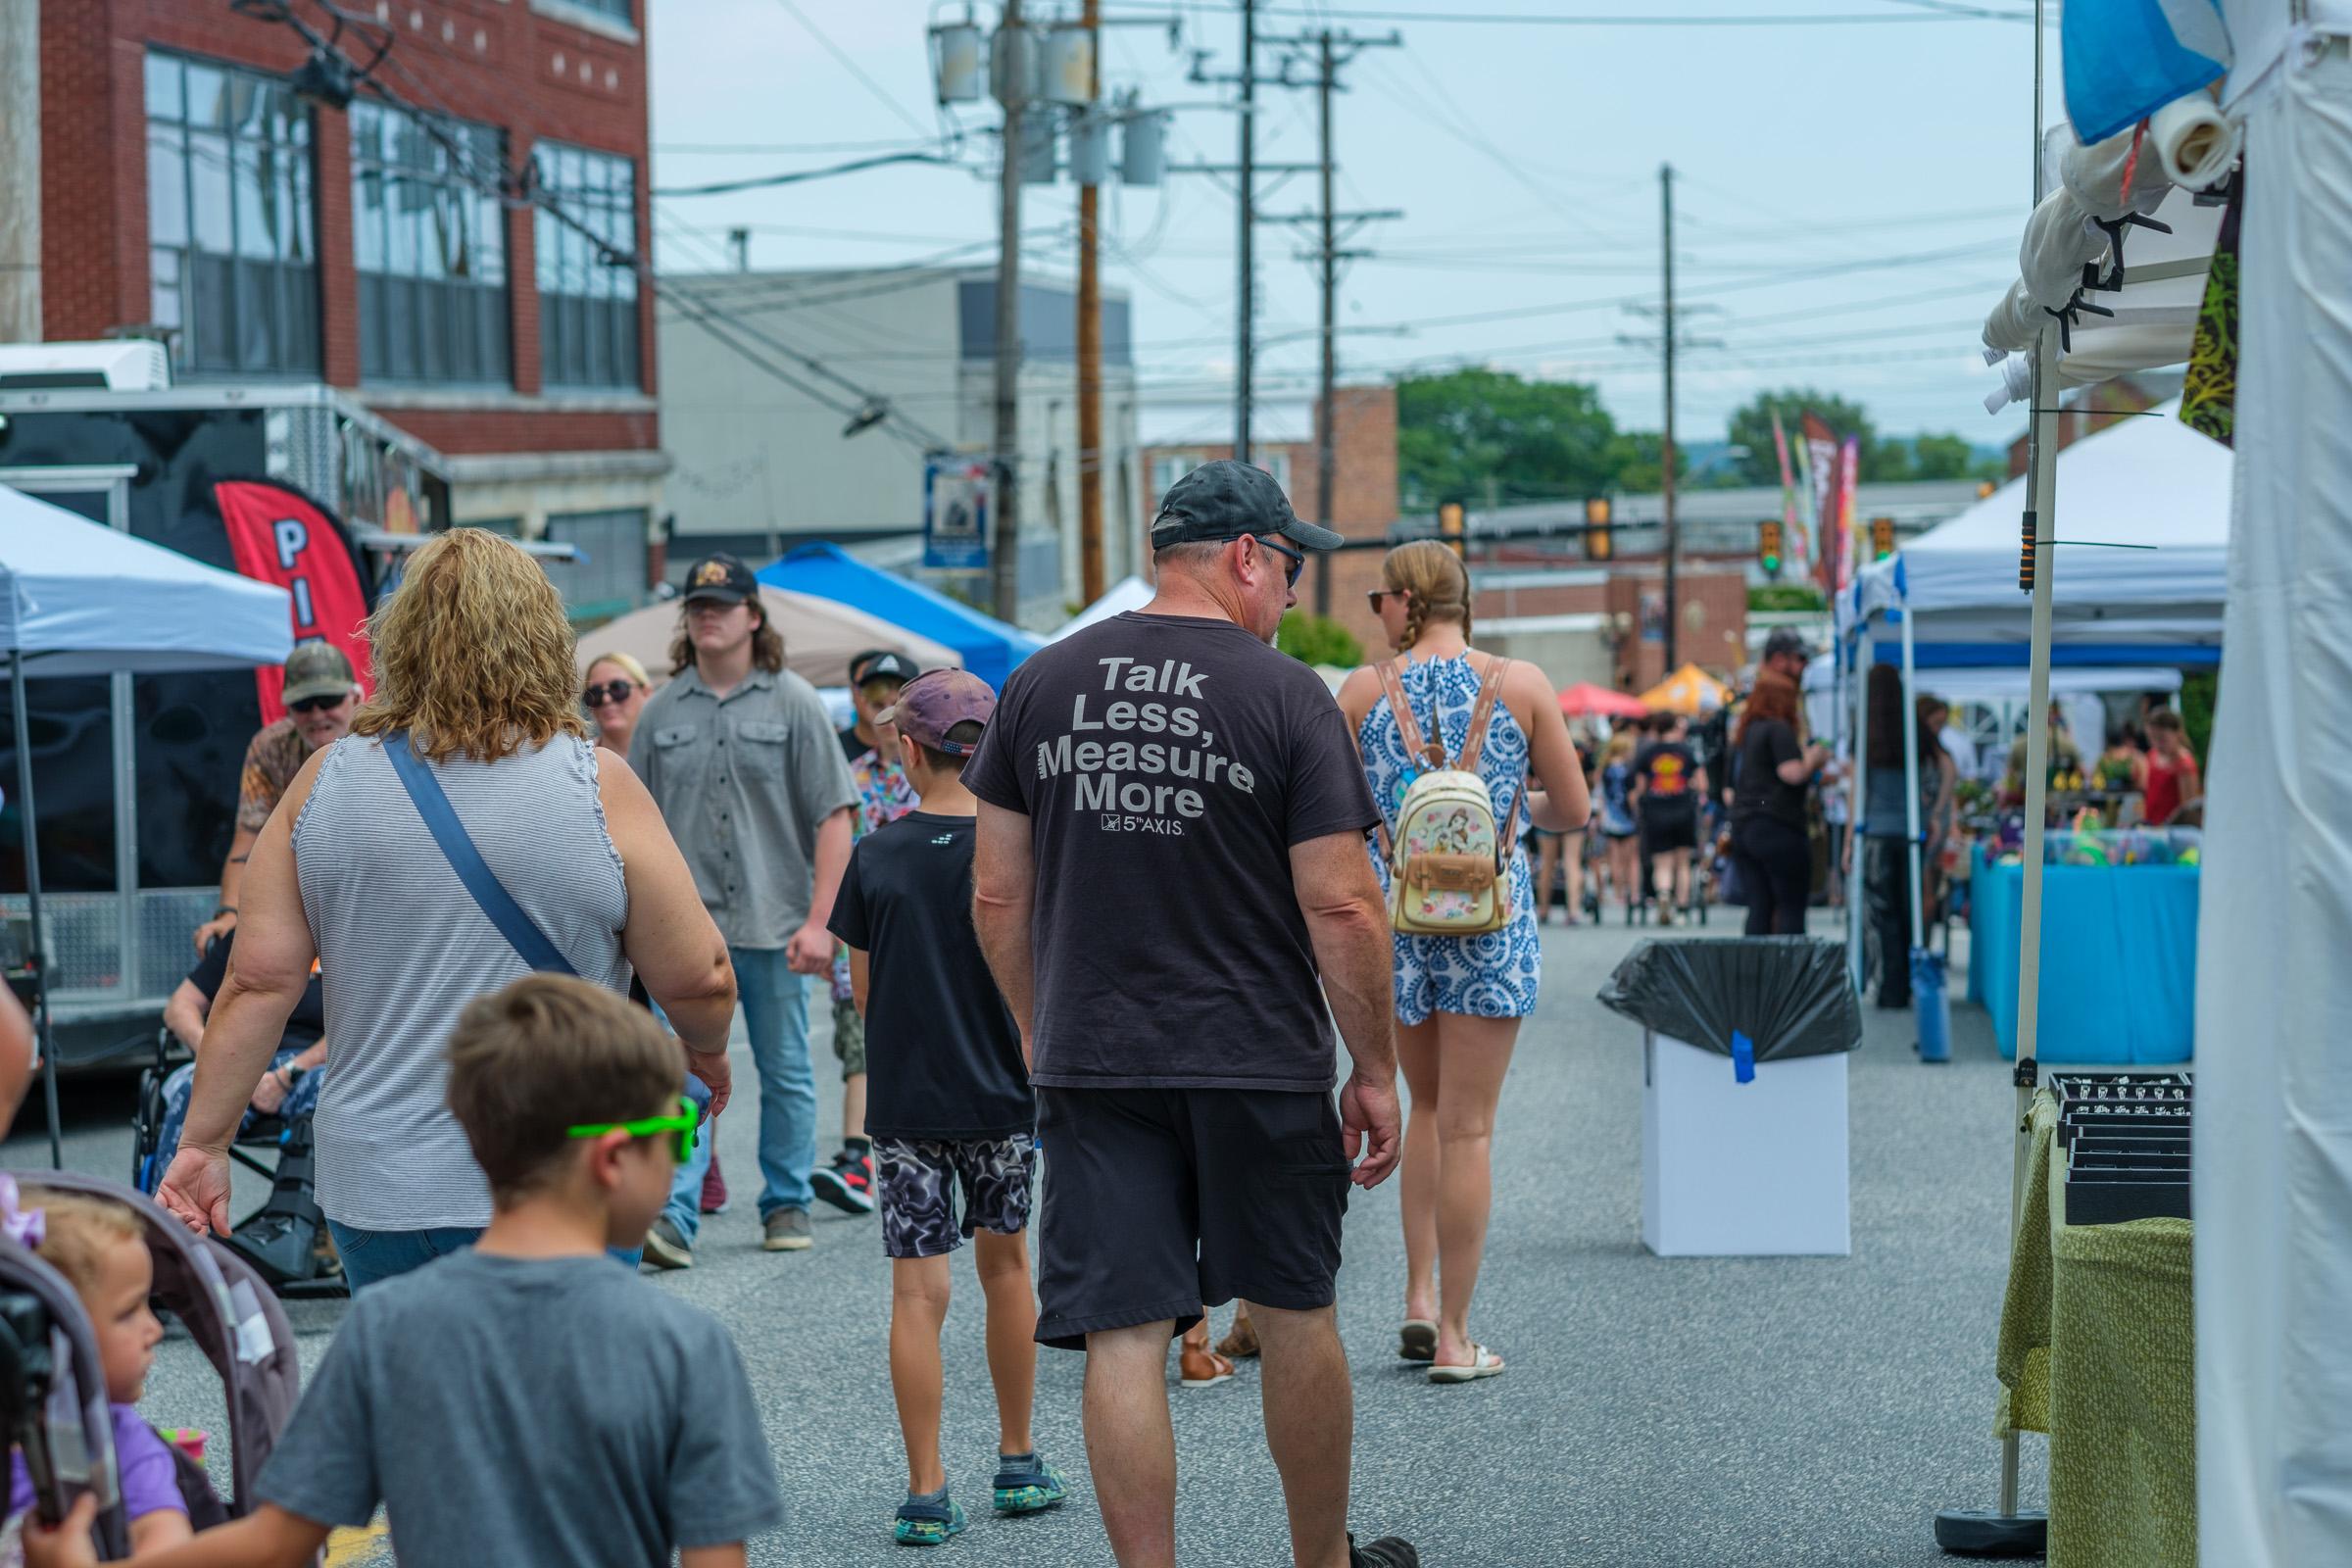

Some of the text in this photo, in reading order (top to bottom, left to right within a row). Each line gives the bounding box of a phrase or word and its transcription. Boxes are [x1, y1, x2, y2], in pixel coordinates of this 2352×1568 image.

[272, 518, 327, 646] PI
[1098, 657, 1209, 700] Talk
[1072, 694, 1213, 748] Less,
[1037, 734, 1255, 794] Measure
[1075, 772, 1204, 818] More
